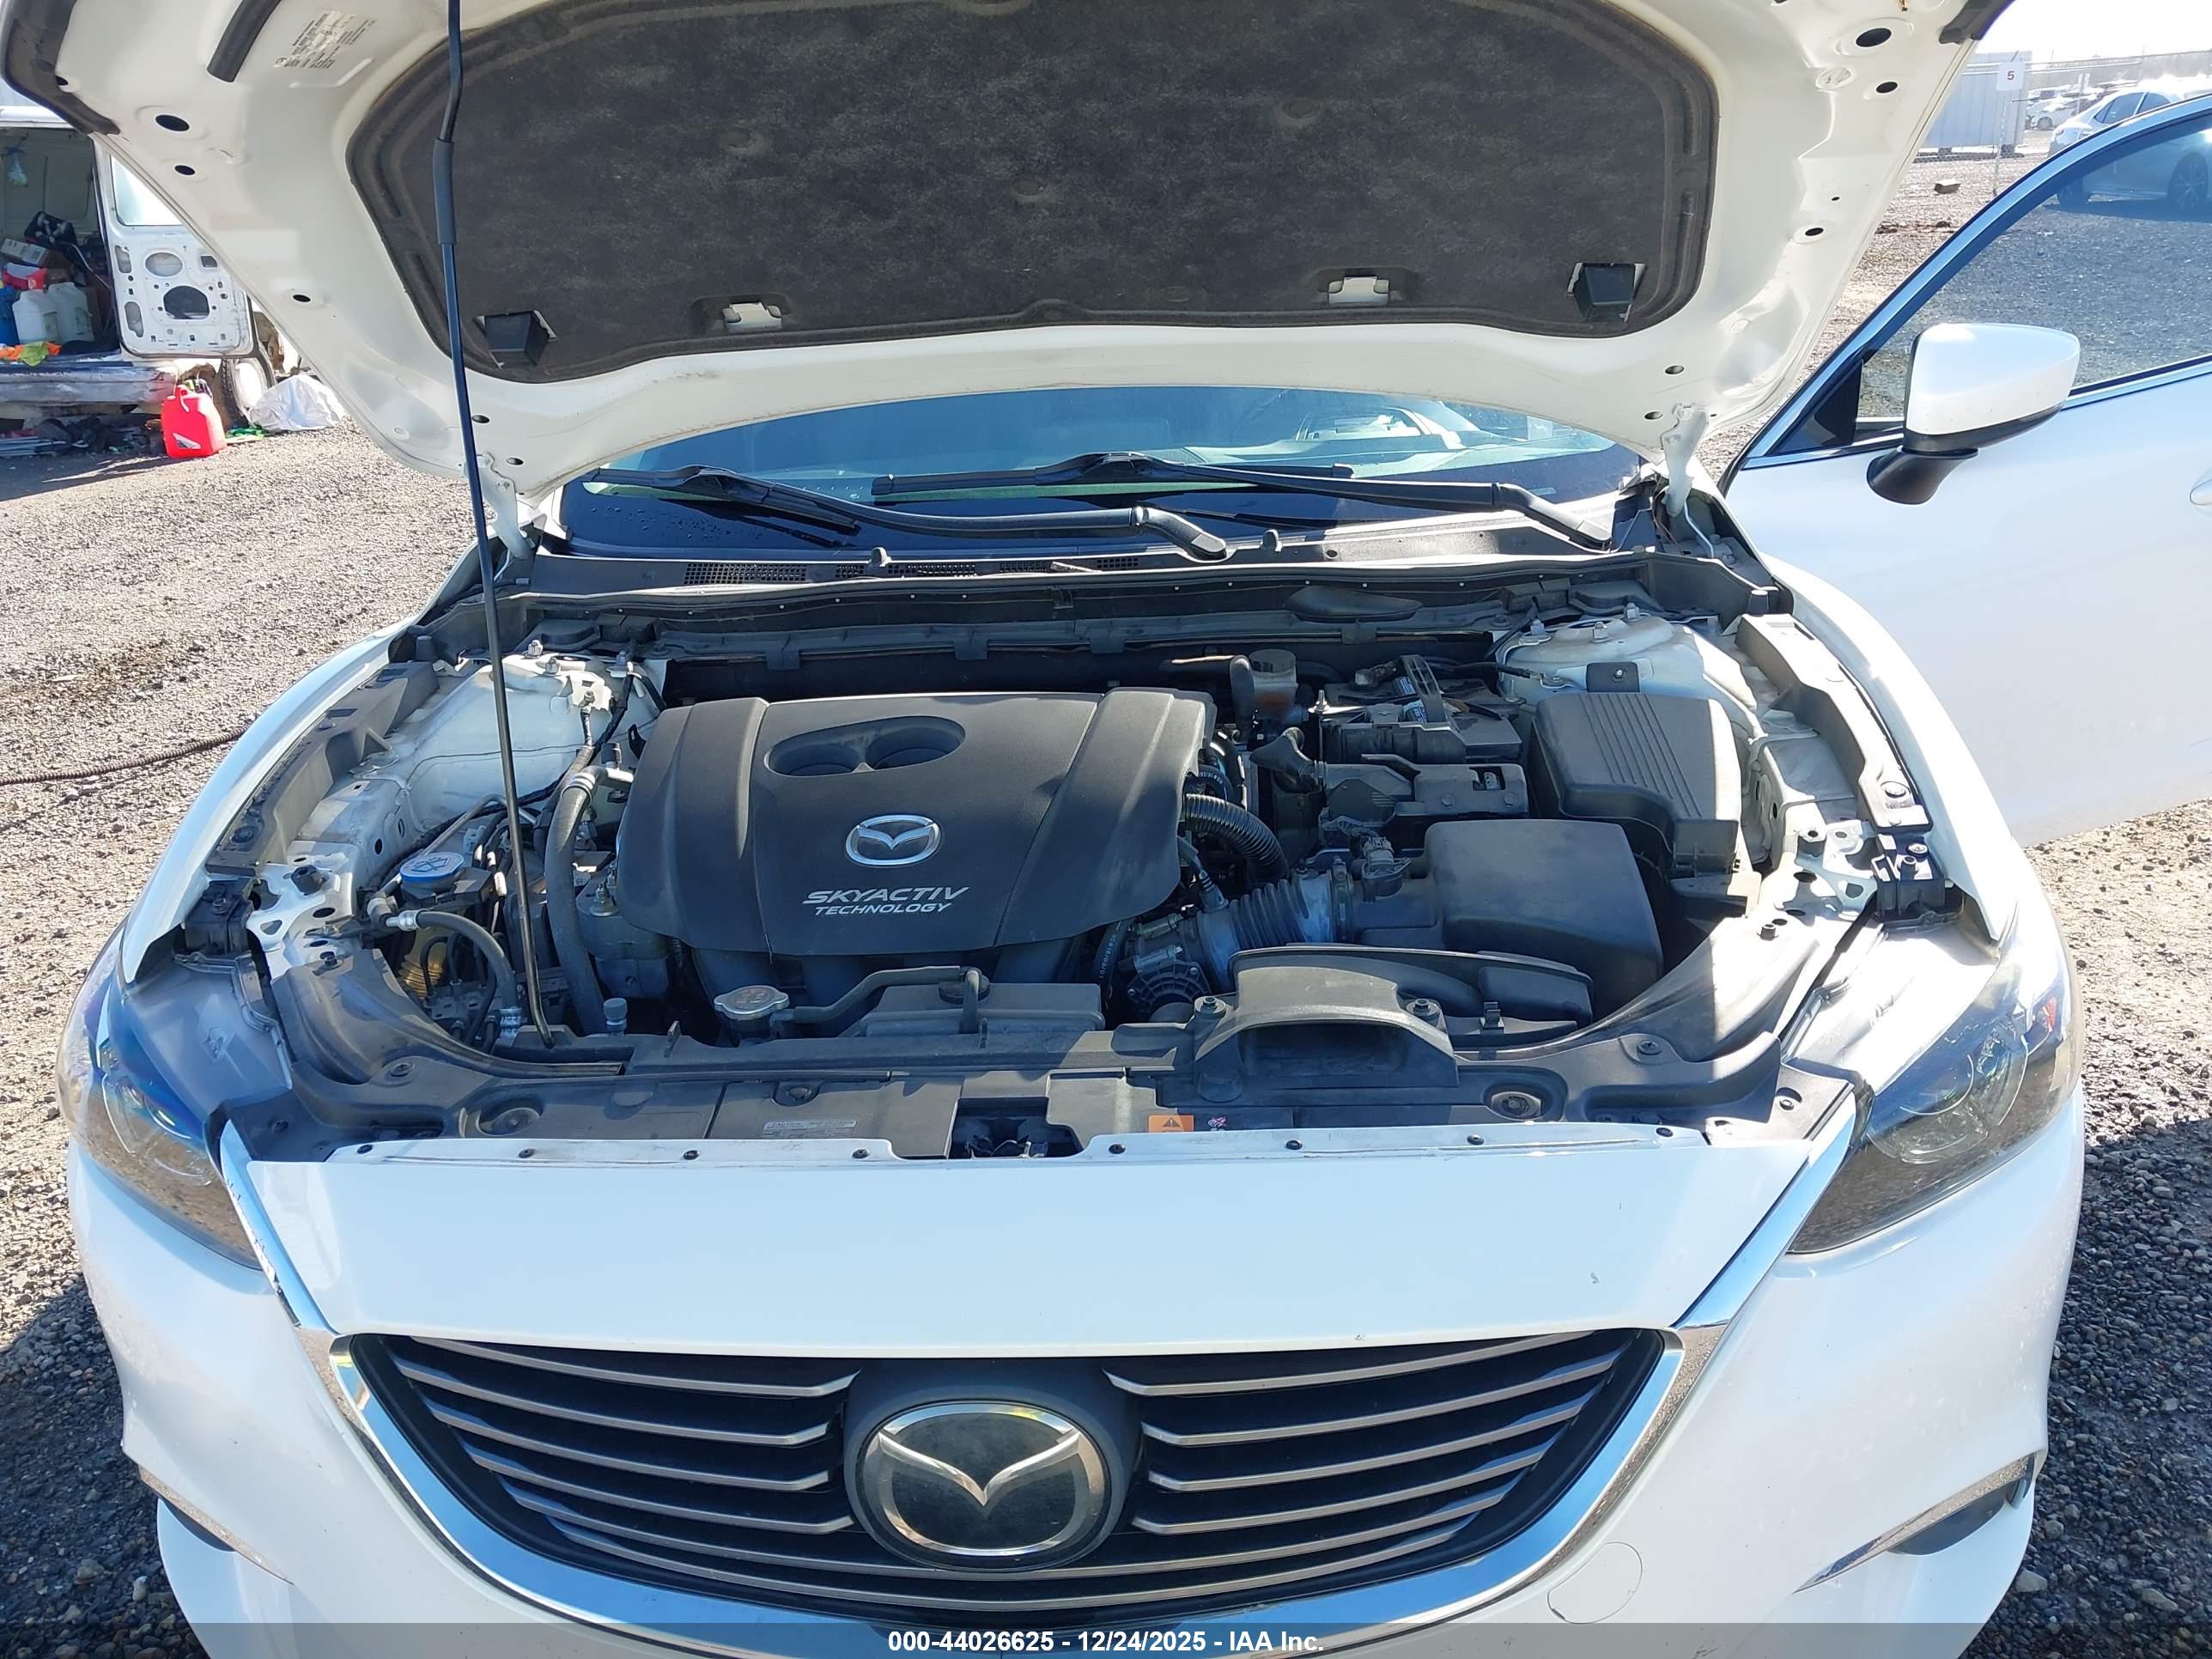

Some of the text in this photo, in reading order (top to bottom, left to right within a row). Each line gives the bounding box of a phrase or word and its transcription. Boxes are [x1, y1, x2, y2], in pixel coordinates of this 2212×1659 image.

[2007, 70, 2014, 81] 5
[802, 886, 969, 904] SKYACTIV
[815, 902, 952, 915] TECHNOLOGY
